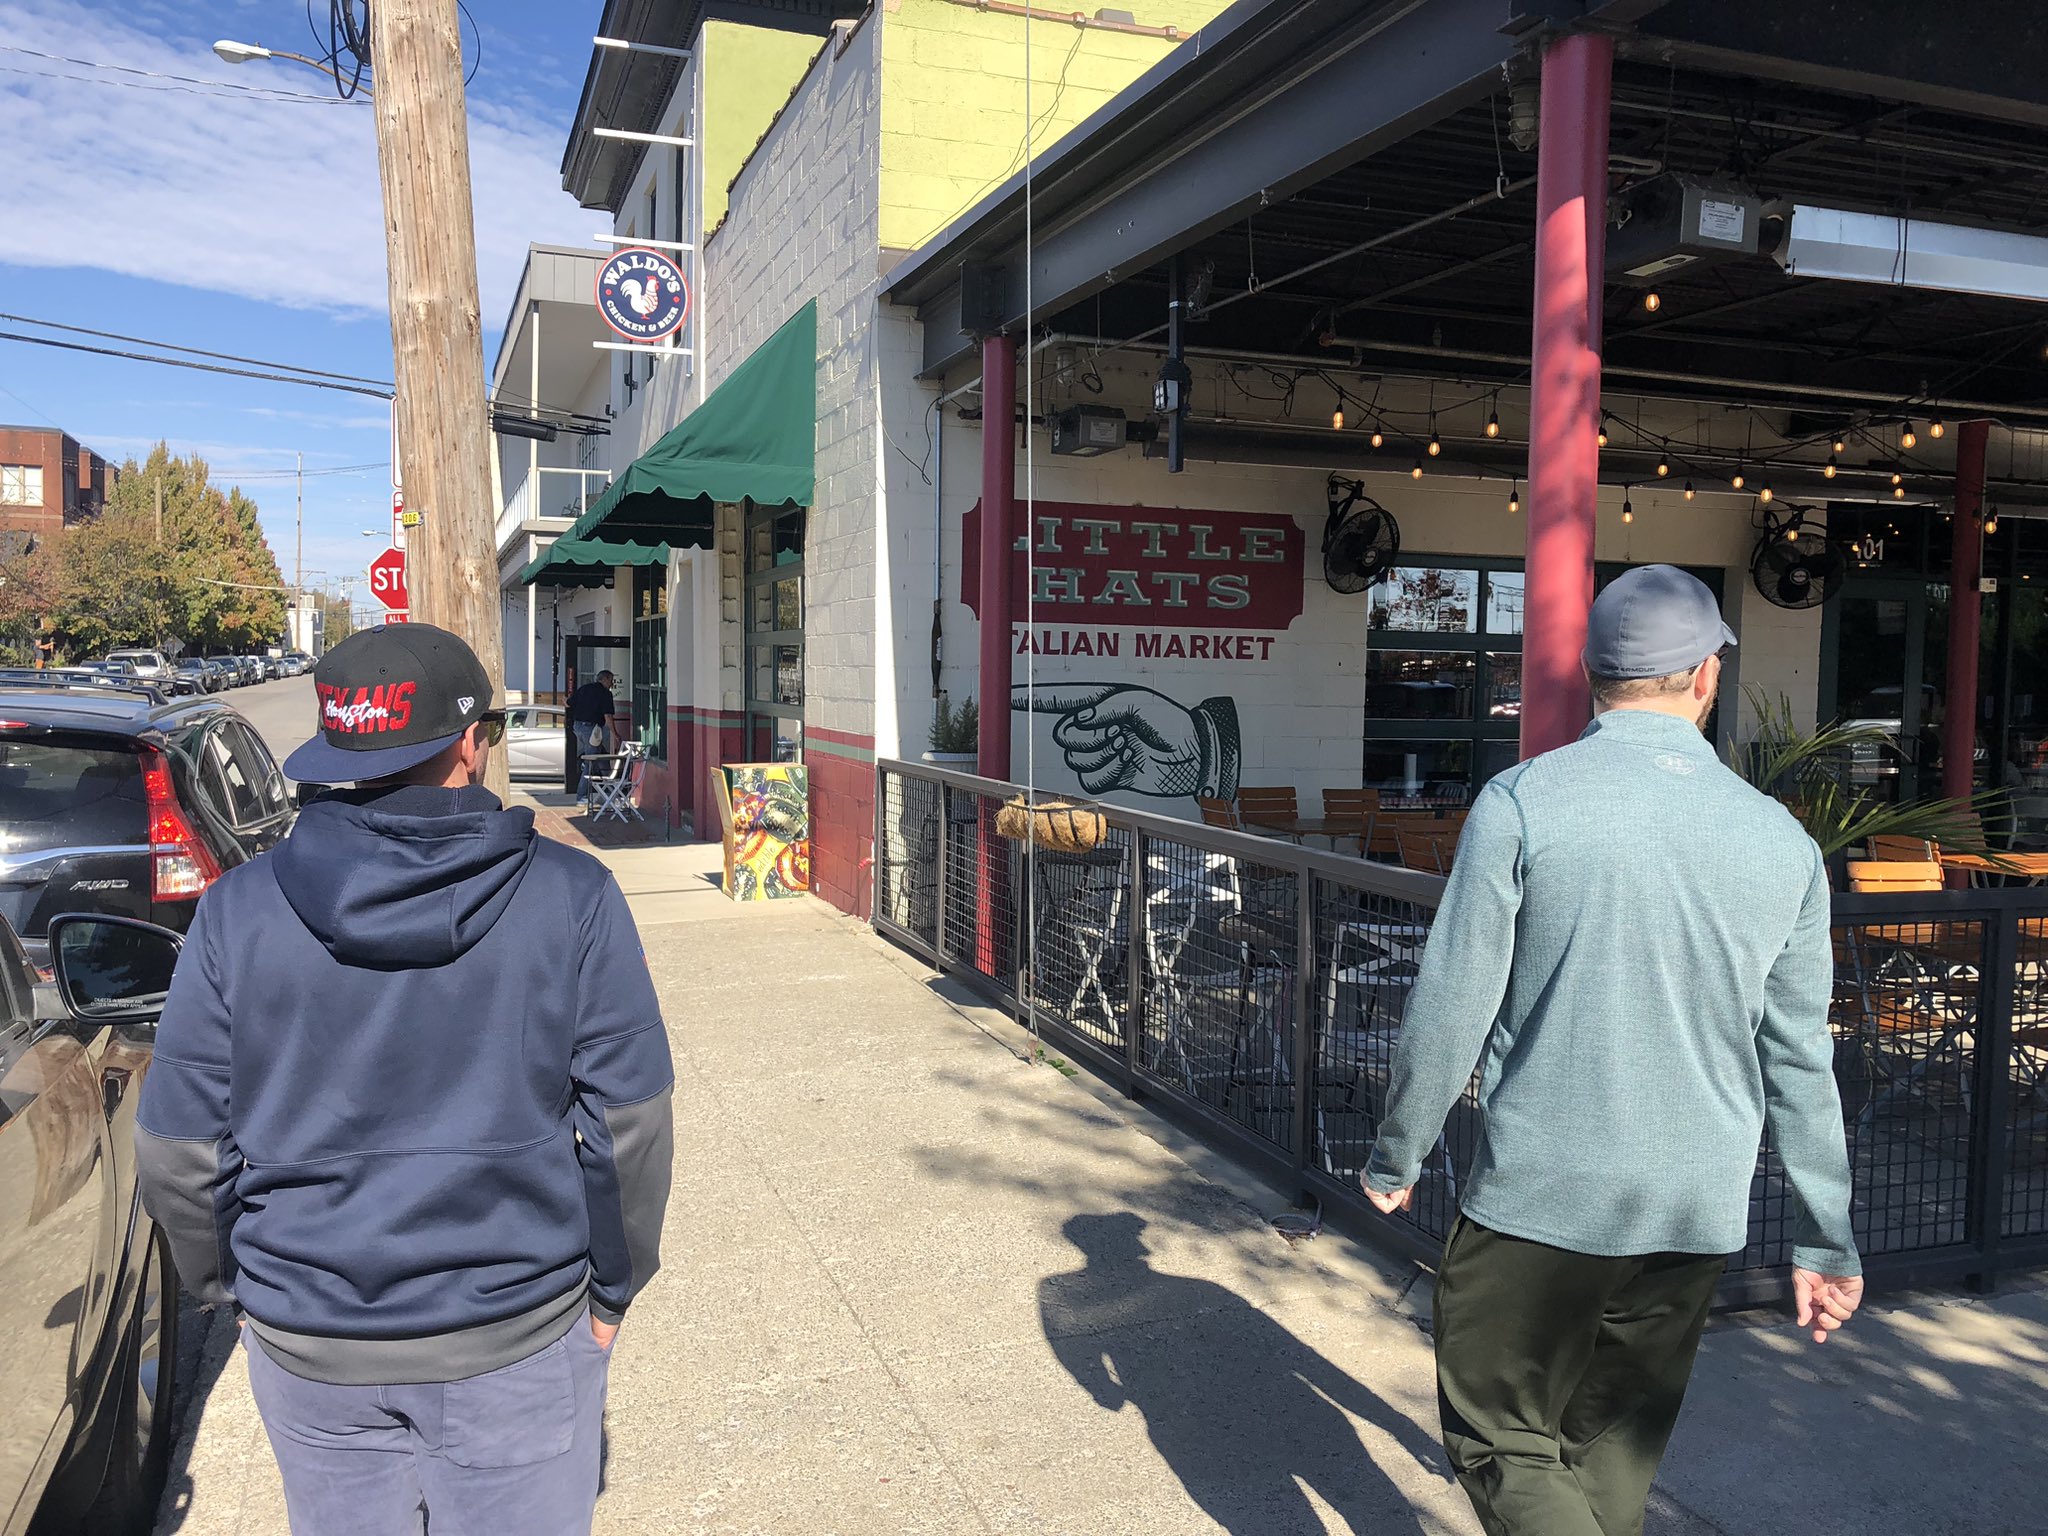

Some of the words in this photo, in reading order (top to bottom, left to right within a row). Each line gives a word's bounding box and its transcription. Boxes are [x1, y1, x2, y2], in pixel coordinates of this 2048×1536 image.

[603, 255, 681, 293] WALDO'S
[606, 300, 646, 332] CHICKEN
[648, 324, 657, 332] &
[657, 307, 679, 329] BEER
[1031, 566, 1250, 609] HATS
[389, 615, 402, 623] ALL
[1011, 630, 1119, 657] ALIAN
[1135, 634, 1275, 660] MARKET
[326, 699, 389, 727] Houston
[69, 879, 130, 890] AWD
